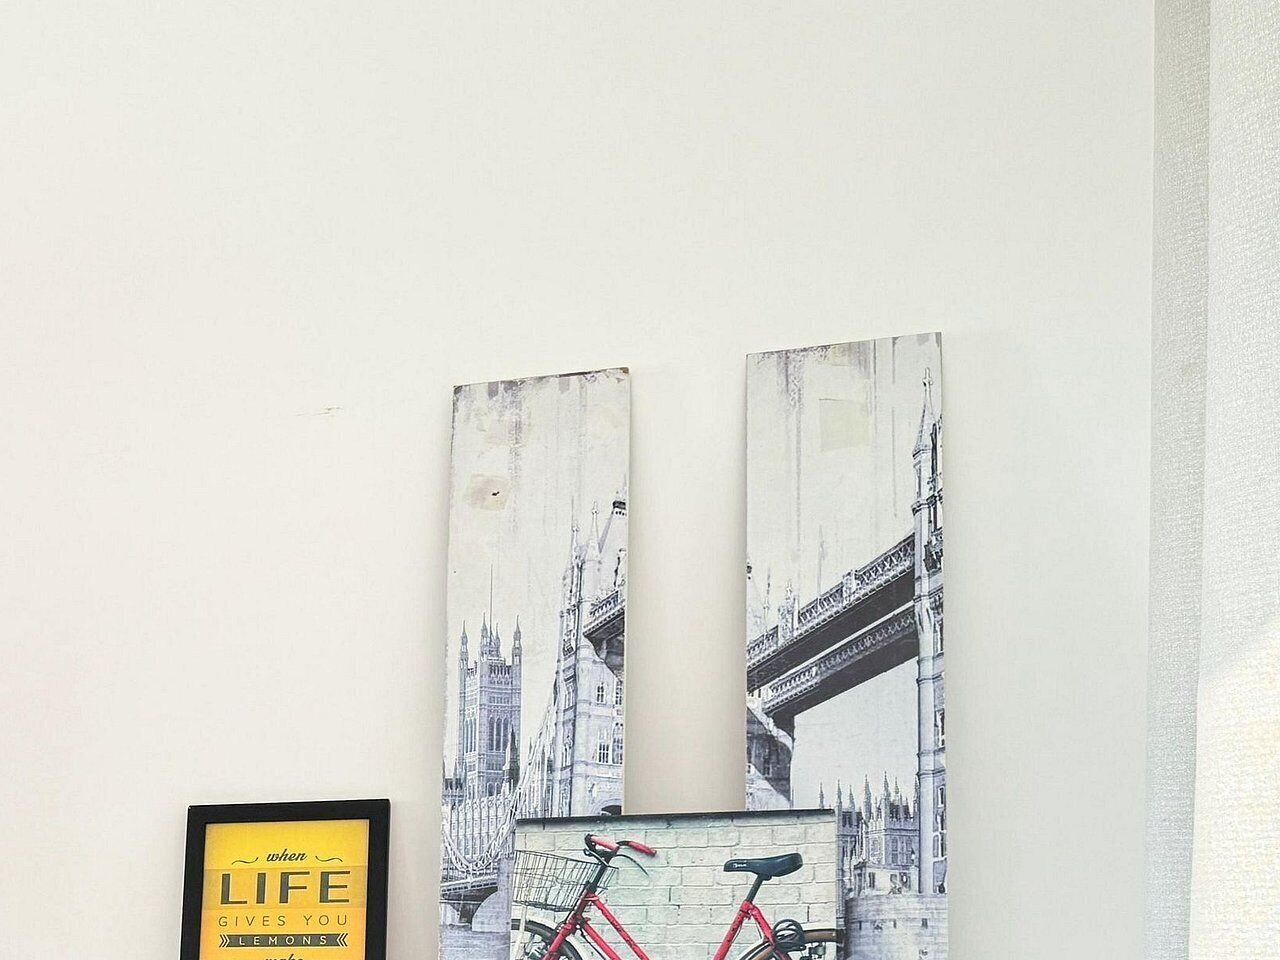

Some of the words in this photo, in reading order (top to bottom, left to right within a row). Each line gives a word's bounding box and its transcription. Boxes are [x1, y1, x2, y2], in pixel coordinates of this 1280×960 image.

[266, 848, 308, 862] when
[220, 871, 351, 905] LIFE
[218, 915, 286, 927] GIVES
[303, 914, 348, 926] YOU
[239, 936, 327, 946] LEMONS
